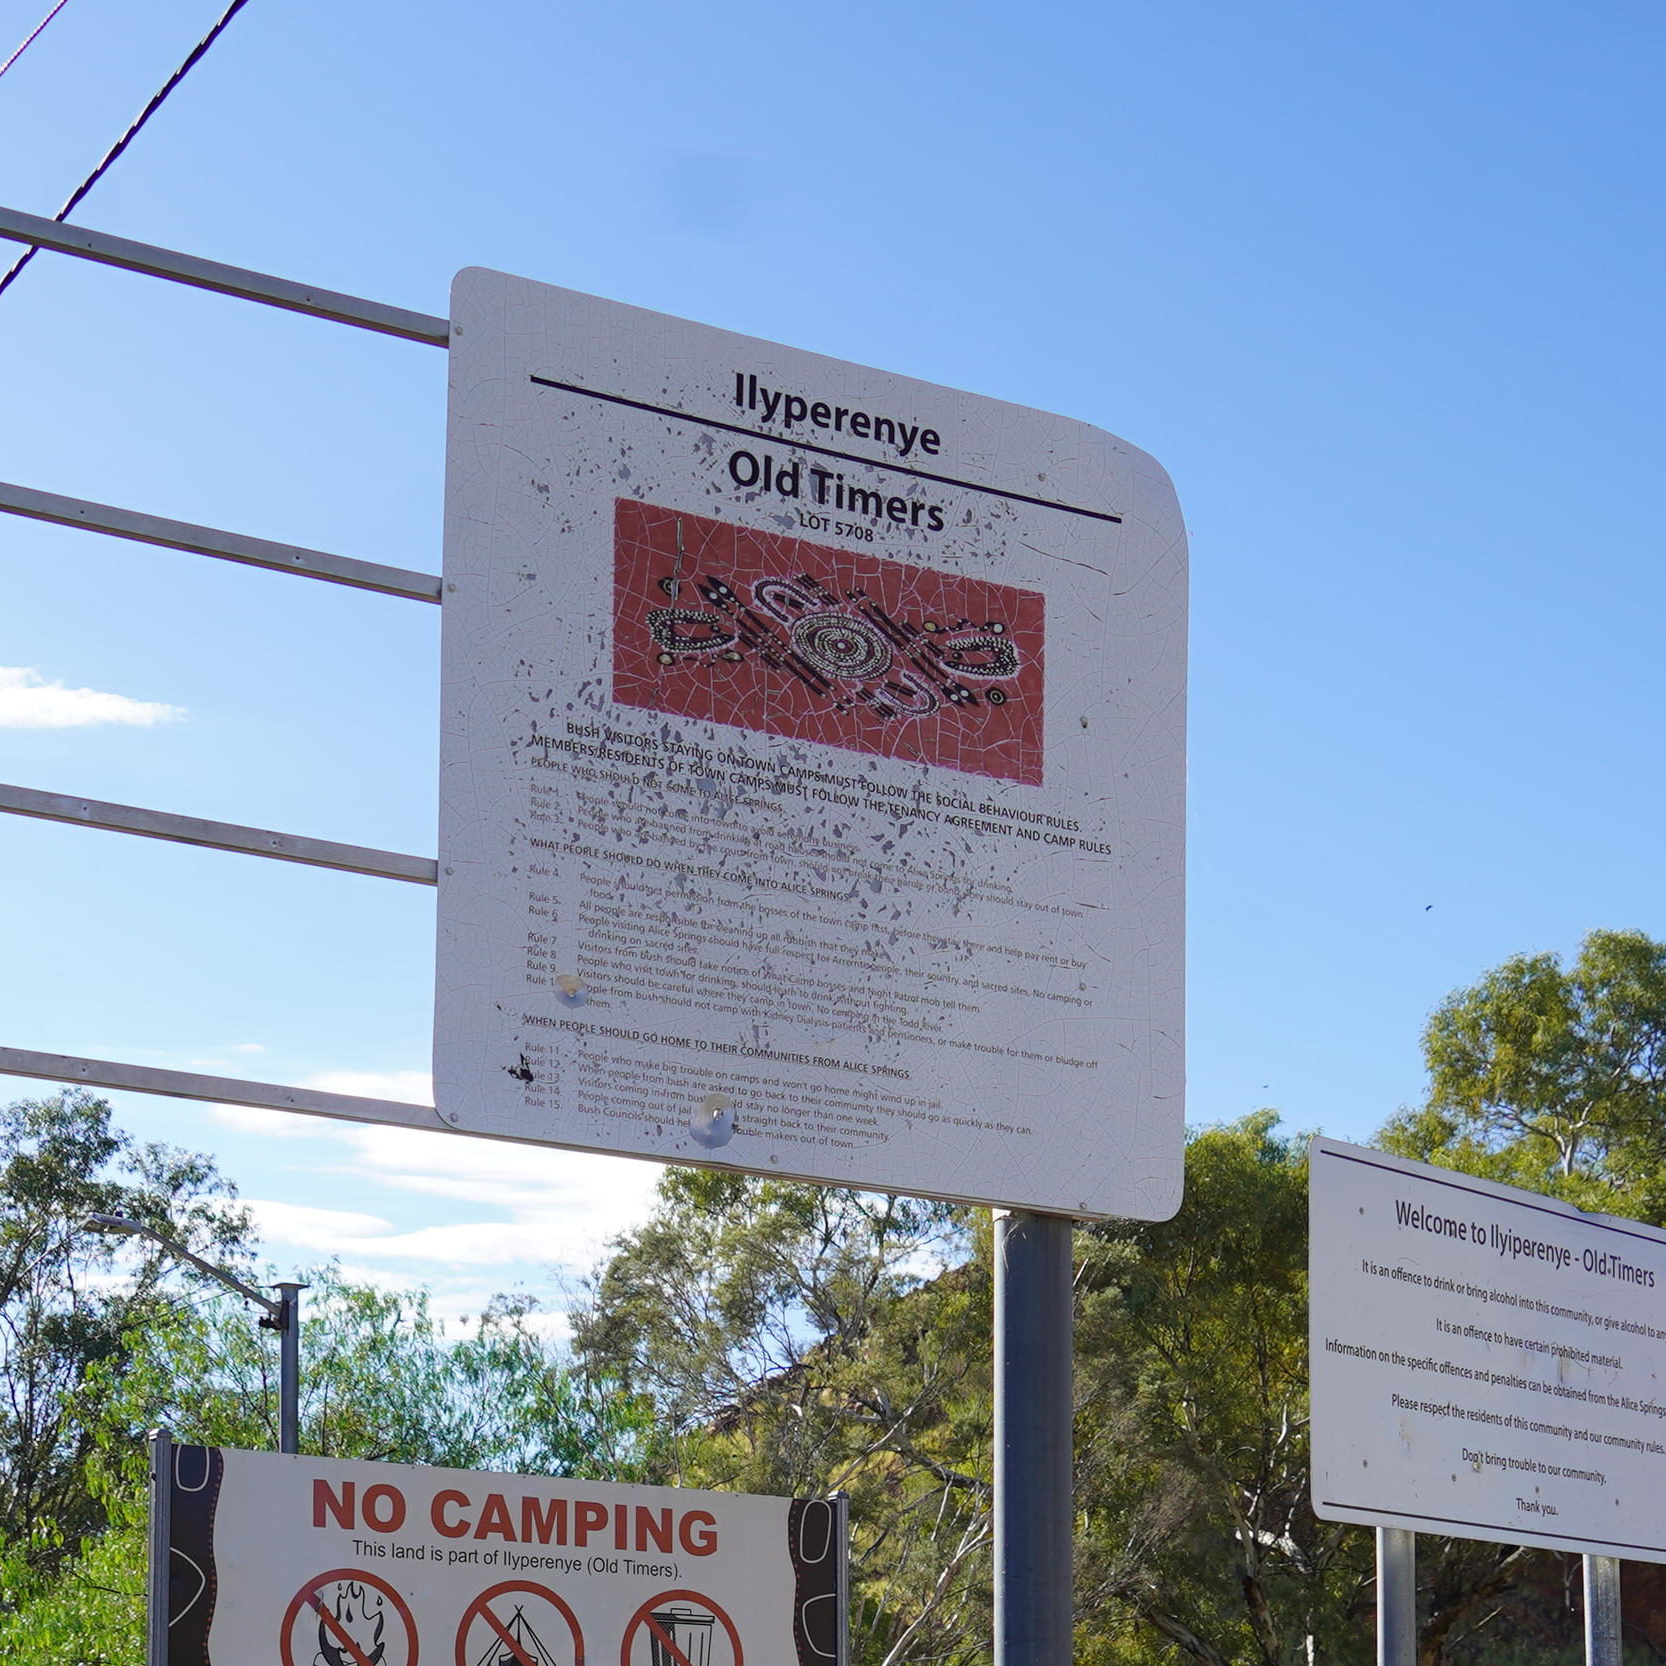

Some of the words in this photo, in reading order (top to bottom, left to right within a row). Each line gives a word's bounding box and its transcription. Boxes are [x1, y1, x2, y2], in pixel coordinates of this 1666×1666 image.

[735, 372, 941, 457] Ilyperenye
[729, 450, 800, 499] Old
[810, 468, 944, 532] Timers
[800, 513, 830, 532] LOT
[835, 522, 874, 542] 5708
[567, 722, 599, 739] BUSH
[604, 727, 659, 750] VISITORS
[662, 741, 713, 761] STAYING
[717, 751, 735, 765] ON
[740, 754, 776, 773] TOWN
[780, 764, 821, 782] CAMPS
[825, 773, 857, 789] MUST
[861, 780, 908, 799] FOLLOW
[912, 790, 932, 804] THE
[936, 794, 976, 813] SOCIAL
[979, 802, 1043, 825] BEHAVIOUR
[668, 760, 685, 773] OF
[688, 764, 725, 781] TOWN
[729, 773, 771, 790] CAMPS
[775, 781, 808, 798] MUST
[812, 788, 860, 807] FOLLOW
[863, 797, 886, 813] THE
[889, 801, 941, 822] TENANCY
[944, 814, 1013, 836] AGREEMENT
[1016, 827, 1041, 842] AND
[1043, 832, 1076, 848] CAMP
[1079, 839, 1112, 856] RULES
[1395, 1198, 1467, 1241] Welcome
[1470, 1221, 1487, 1245] to
[1490, 1222, 1571, 1270] Ilyiperenye
[1582, 1247, 1607, 1276] Old
[1609, 1255, 1655, 1288] Timers
[1362, 1257, 1369, 1273] It
[1370, 1260, 1378, 1275] is
[1378, 1265, 1390, 1278] an
[1390, 1265, 1423, 1285] offence
[1423, 1273, 1433, 1288] to
[1433, 1274, 1456, 1293] drink
[1455, 1283, 1466, 1294] or
[1466, 1281, 1488, 1303] bring
[1488, 1288, 1518, 1307] alcohol
[1518, 1297, 1535, 1310] into
[1535, 1298, 1550, 1314] this
[1550, 1304, 1594, 1326] community,
[1594, 1315, 1603, 1326] or
[1603, 1317, 1620, 1331] give
[1620, 1318, 1647, 1336] alcohol
[1647, 1325, 1656, 1338] to
[1325, 1336, 1377, 1360] Information
[1378, 1350, 1390, 1363] on
[1391, 1349, 1406, 1367] the
[1406, 1356, 1438, 1373] specific
[1438, 1360, 1473, 1379] offences
[1473, 1368, 1490, 1382] and
[1490, 1372, 1528, 1390] penalties
[1527, 1379, 1542, 1392] can
[1542, 1380, 1553, 1395] be
[1552, 1383, 1587, 1402] obtained
[1587, 1389, 1607, 1405] from
[1606, 1392, 1620, 1408] the
[1620, 1395, 1639, 1412] Alice
[1639, 1399, 1666, 1419] Springs
[1436, 1317, 1443, 1331] It
[1443, 1321, 1451, 1334] is
[1451, 1323, 1463, 1335] an
[1463, 1323, 1493, 1342] offence
[1493, 1331, 1503, 1344] to
[1503, 1331, 1524, 1348] have
[1524, 1338, 1550, 1354] certain
[1550, 1341, 1590, 1363] prohibited
[1590, 1353, 1623, 1370] material.
[1391, 1392, 1419, 1411] Please
[1419, 1401, 1451, 1417] respect
[1451, 1403, 1466, 1420] the
[1466, 1408, 1503, 1426] residents
[1503, 1413, 1513, 1428] of
[1513, 1415, 1529, 1430] this
[1529, 1420, 1573, 1441] community
[1573, 1427, 1589, 1441] and
[1589, 1431, 1603, 1444] our
[1603, 1434, 1645, 1454] community
[1645, 1440, 1666, 1454] rules.
[1461, 1447, 1484, 1466] Don't
[1485, 1450, 1507, 1471] bring
[1507, 1455, 1537, 1472] trouble
[1537, 1461, 1547, 1474] to
[1547, 1464, 1562, 1476] our
[1562, 1467, 1607, 1486] community.
[313, 1479, 406, 1534] NO
[431, 1489, 717, 1557] CAMPING
[1515, 1496, 1541, 1513] Thank
[1541, 1503, 1559, 1517] you.
[352, 1538, 387, 1558] This
[391, 1542, 425, 1560] land
[430, 1544, 444, 1562] is
[448, 1548, 479, 1565] part
[483, 1548, 499, 1565] of
[503, 1550, 582, 1574] Ilyperenye
[587, 1555, 620, 1577] (Old
[623, 1557, 684, 1581] Timers).
